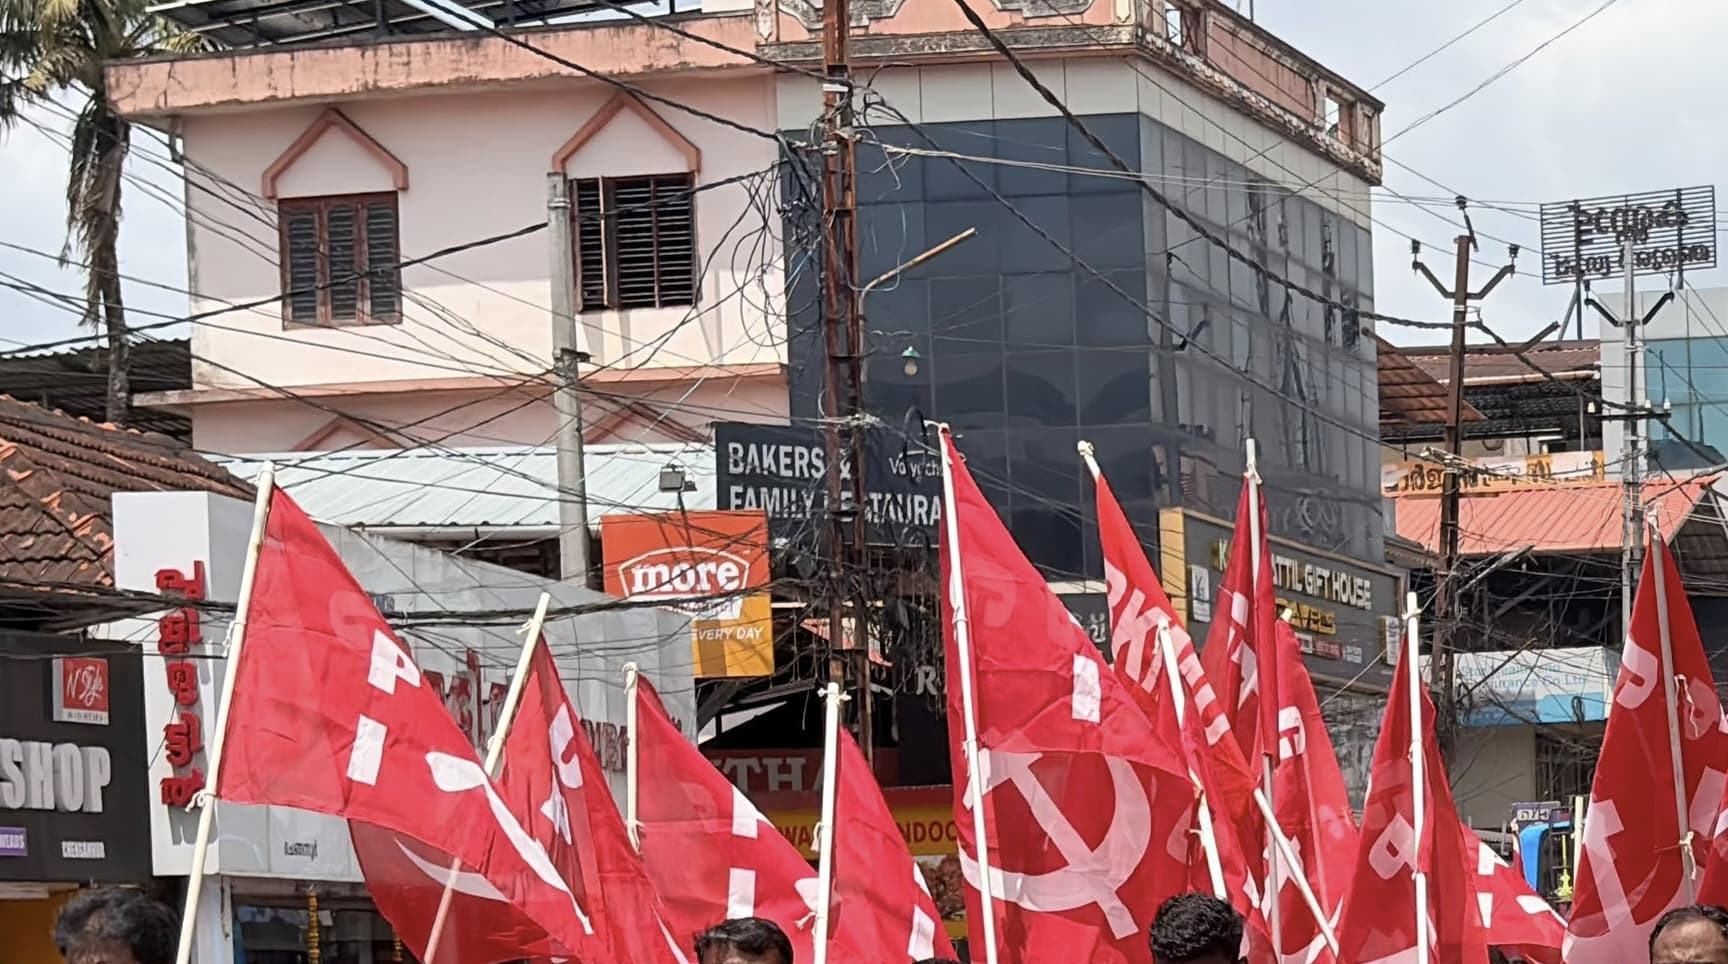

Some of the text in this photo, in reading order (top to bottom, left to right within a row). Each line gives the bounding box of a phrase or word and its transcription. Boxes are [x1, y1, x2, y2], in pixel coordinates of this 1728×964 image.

[728, 442, 825, 479] BAKERS
[632, 560, 741, 593] more
[1304, 563, 1329, 600] GIFT
[1331, 572, 1372, 611] HOUSE
[736, 626, 763, 640] DAY
[0, 737, 111, 813] SHOP
